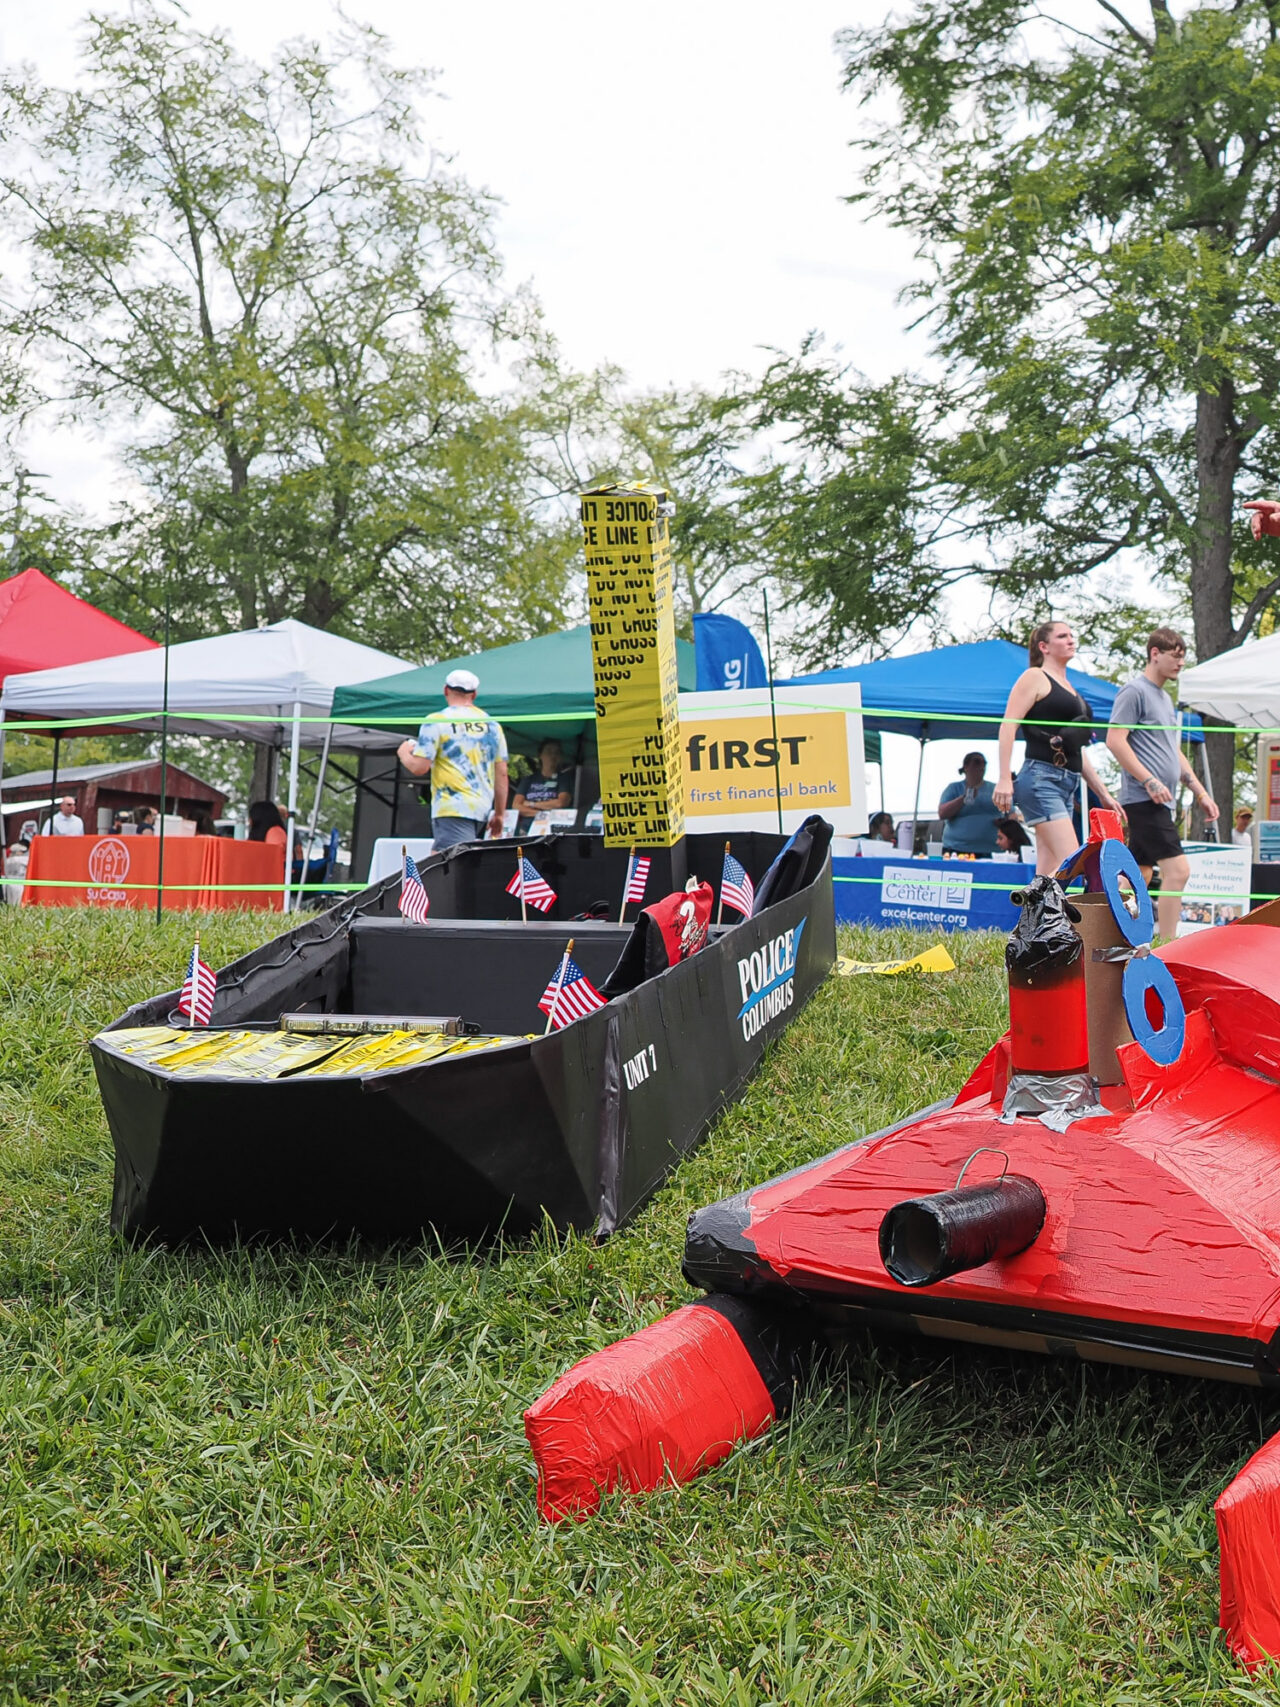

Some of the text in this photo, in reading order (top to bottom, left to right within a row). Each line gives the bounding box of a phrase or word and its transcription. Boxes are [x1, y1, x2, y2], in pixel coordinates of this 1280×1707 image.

[606, 526, 638, 545] LINE
[690, 788, 722, 802] first
[799, 780, 837, 795] bank
[886, 883, 936, 902] Center
[881, 907, 968, 927] excelcenter.org
[737, 928, 795, 1004] POLICE
[742, 977, 794, 1042] COLUMBUS
[623, 1043, 657, 1090] UNIT 7
